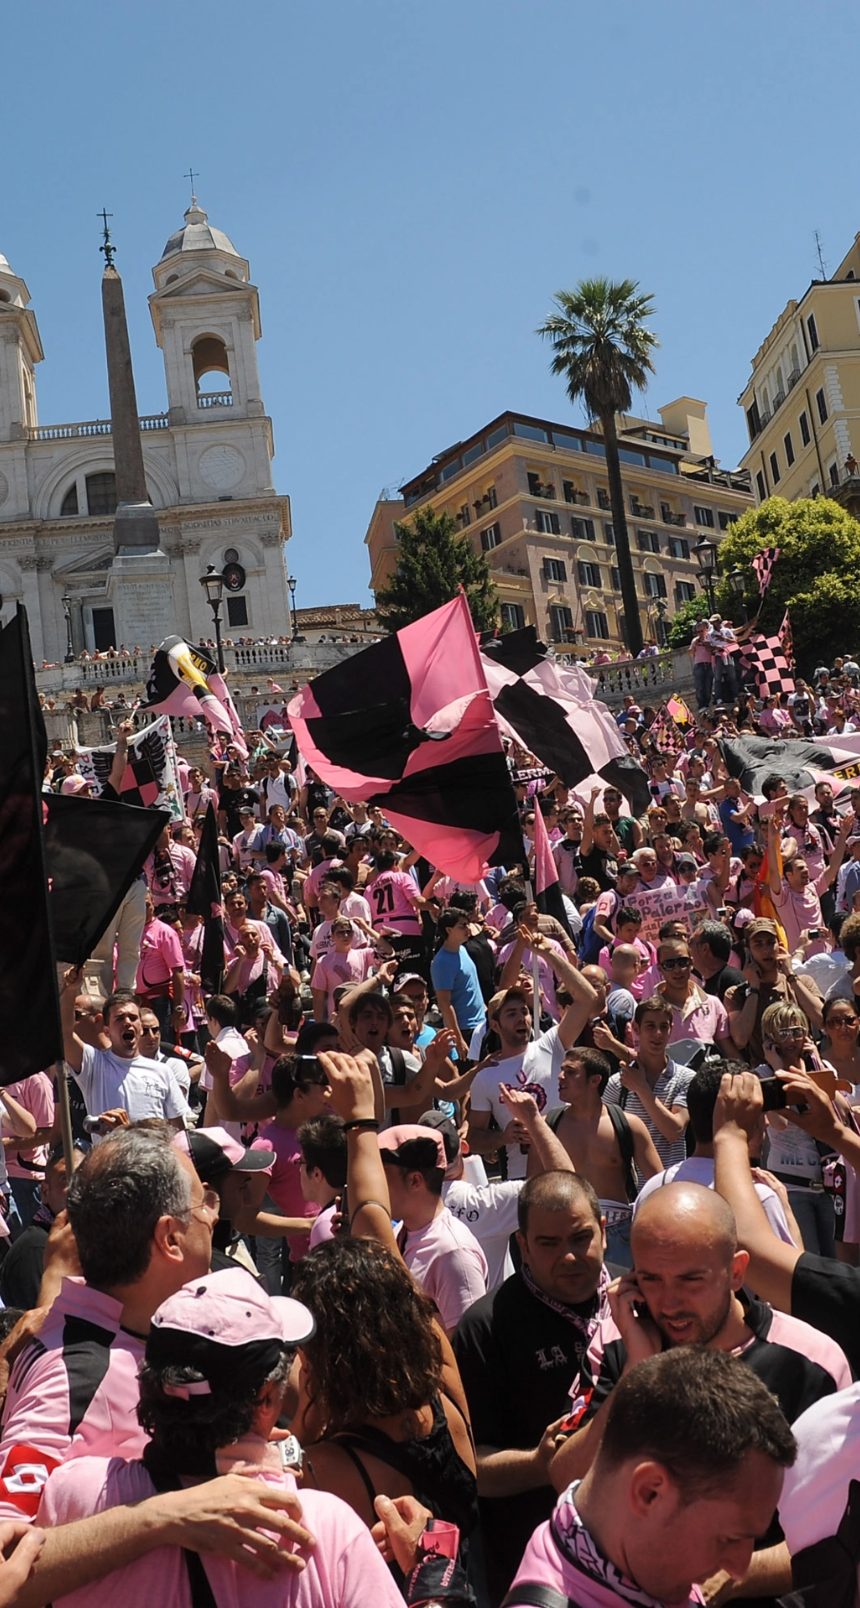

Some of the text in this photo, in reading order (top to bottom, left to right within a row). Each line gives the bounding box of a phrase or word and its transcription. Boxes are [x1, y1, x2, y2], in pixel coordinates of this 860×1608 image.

[510, 766, 556, 782] LERM
[833, 762, 860, 781] ER
[626, 890, 673, 907] Forza
